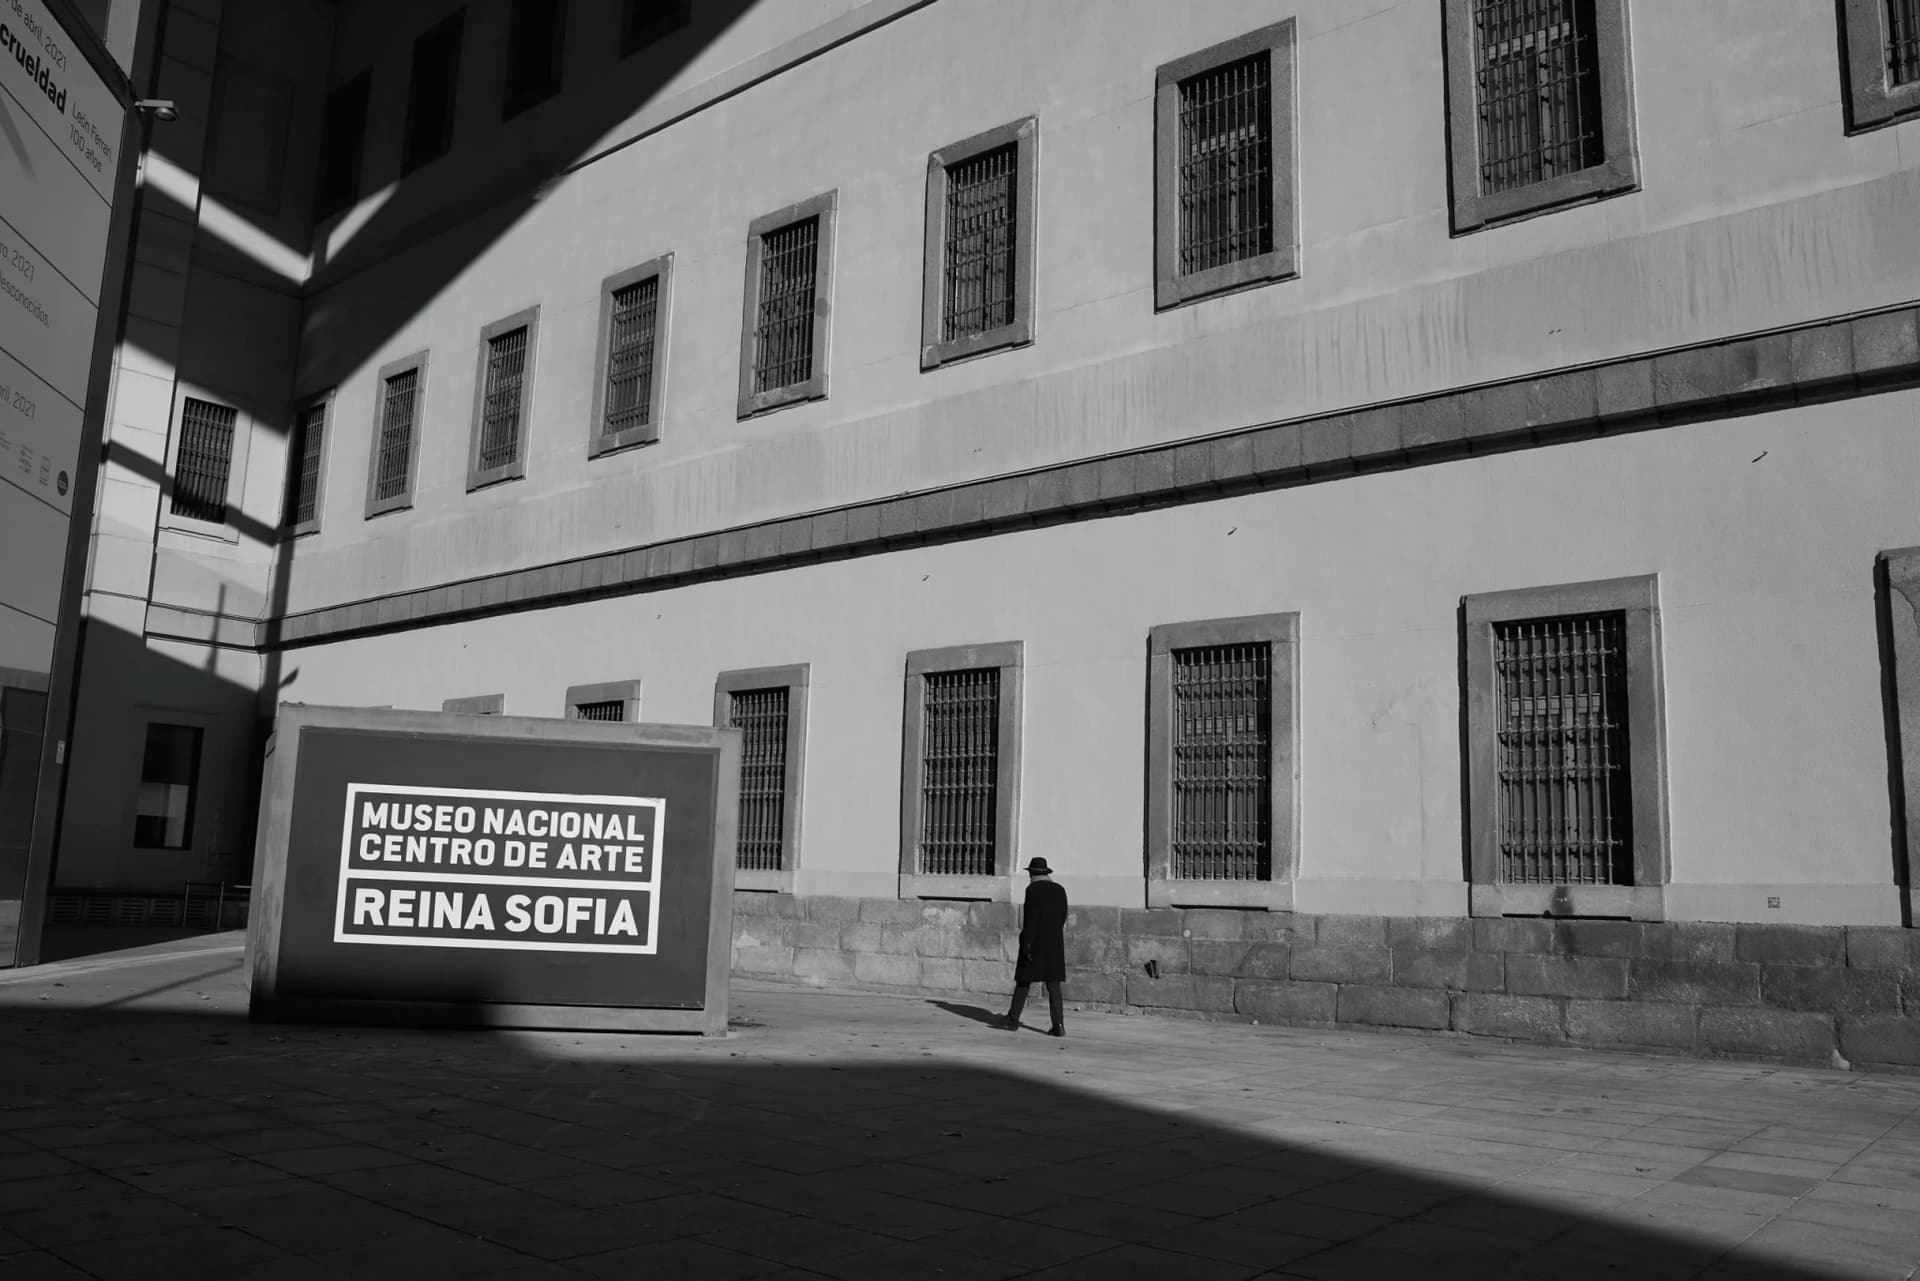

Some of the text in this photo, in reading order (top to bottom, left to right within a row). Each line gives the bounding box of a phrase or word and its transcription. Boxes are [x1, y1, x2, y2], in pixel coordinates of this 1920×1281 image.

[0, 23, 67, 115] crueldad
[45, 36, 67, 72] 2021
[72, 101, 90, 134] León
[70, 123, 102, 173] 100 años
[11, 250, 35, 283] 2021
[12, 391, 35, 420] 2021
[361, 801, 645, 841] MUSEO NACIONAL
[359, 833, 645, 873] CENTRO DE ARTE
[353, 887, 639, 936] REINA SOFIA
